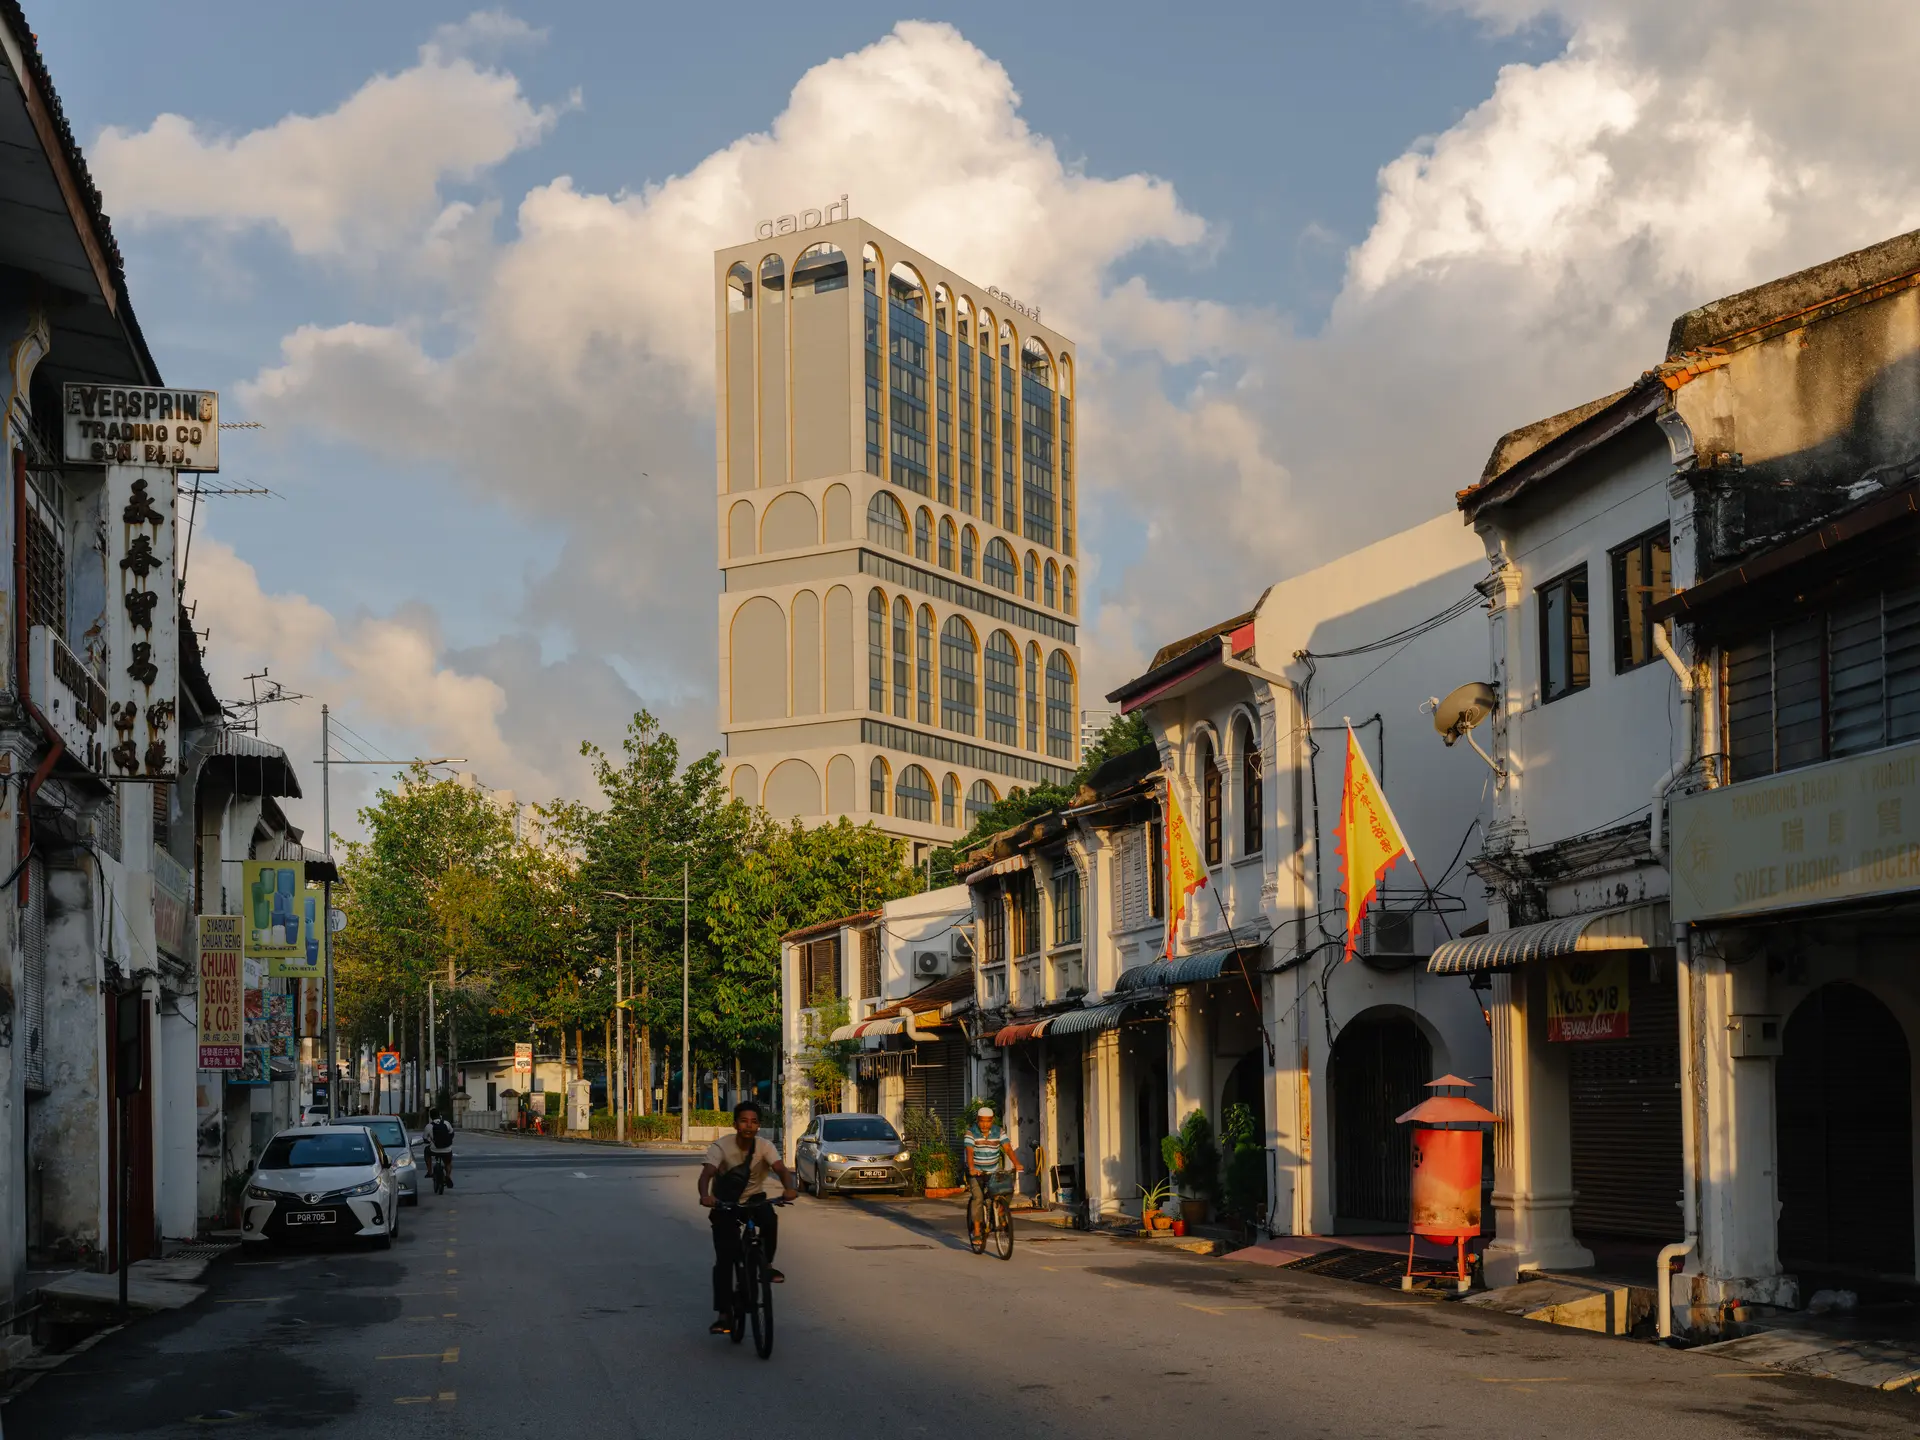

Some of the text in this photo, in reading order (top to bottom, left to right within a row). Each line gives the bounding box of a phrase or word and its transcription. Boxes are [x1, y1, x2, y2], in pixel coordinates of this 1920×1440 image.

[755, 194, 849, 241] capri
[67, 386, 212, 422] EVERSPRING
[79, 420, 202, 444] TRADING CO
[1734, 842, 1920, 901] SWEE KHONG ROCER
[206, 919, 235, 933] SYARIKAT
[201, 935, 241, 948] CHUAN SENG
[201, 952, 236, 978] CHUAN
[204, 979, 231, 1005] SENG
[203, 1007, 232, 1031] & CO.
[312, 1213, 326, 1221] 705
